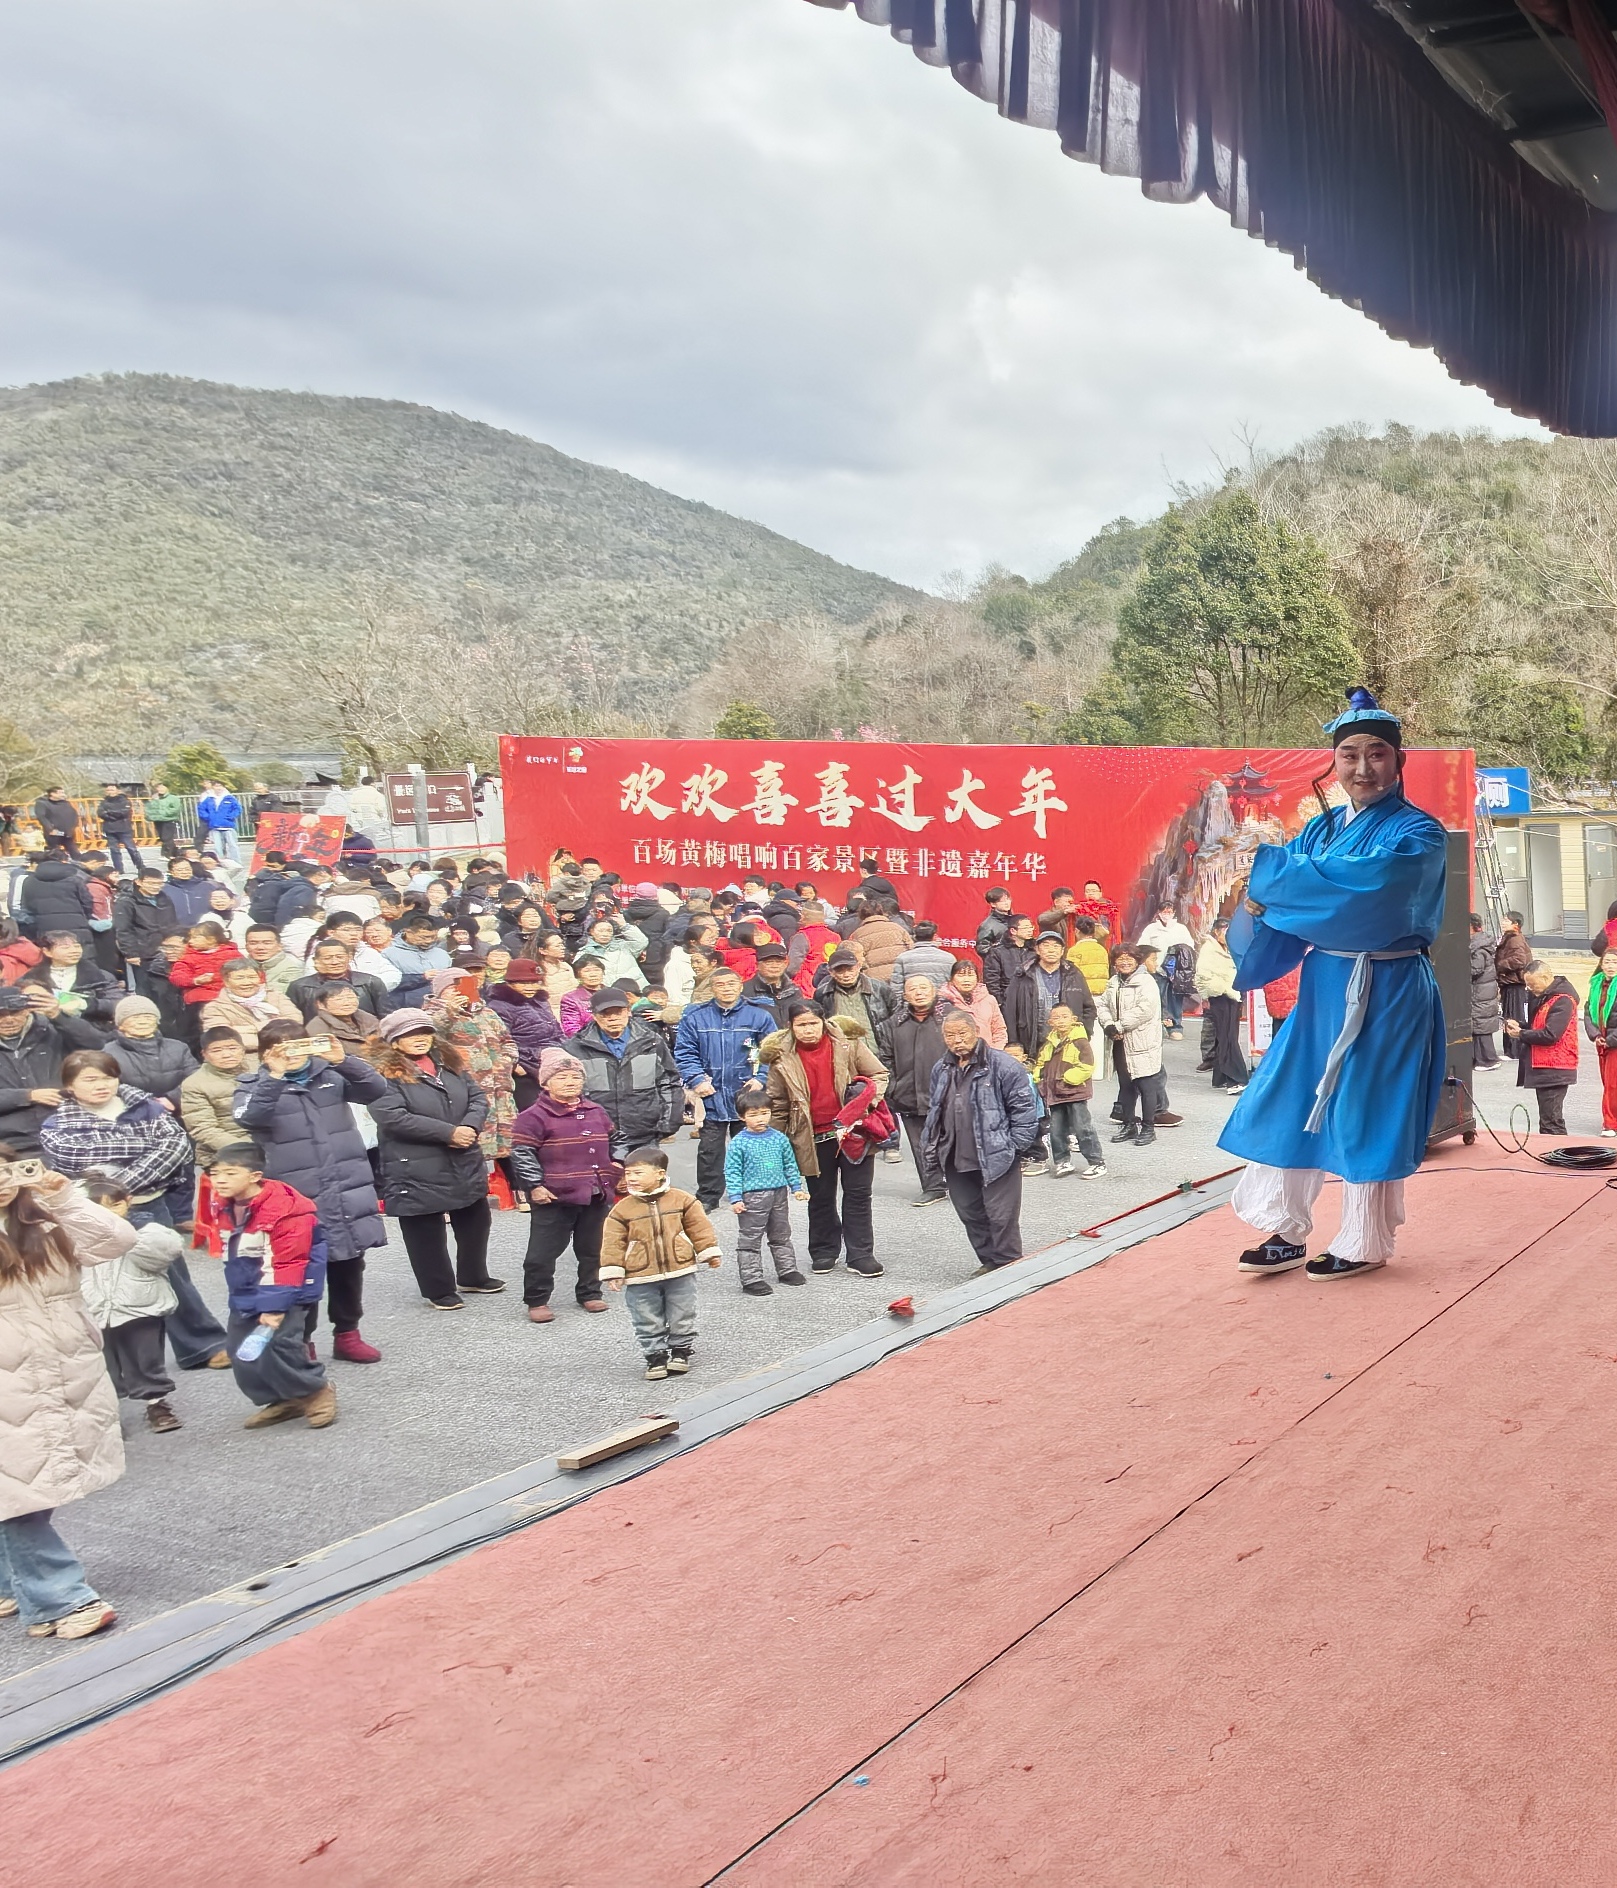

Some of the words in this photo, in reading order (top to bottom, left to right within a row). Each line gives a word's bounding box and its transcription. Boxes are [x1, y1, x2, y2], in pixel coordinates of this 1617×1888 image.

[394, 784, 437, 797] 景区口
[620, 760, 1068, 839] 欢欢喜喜过大年
